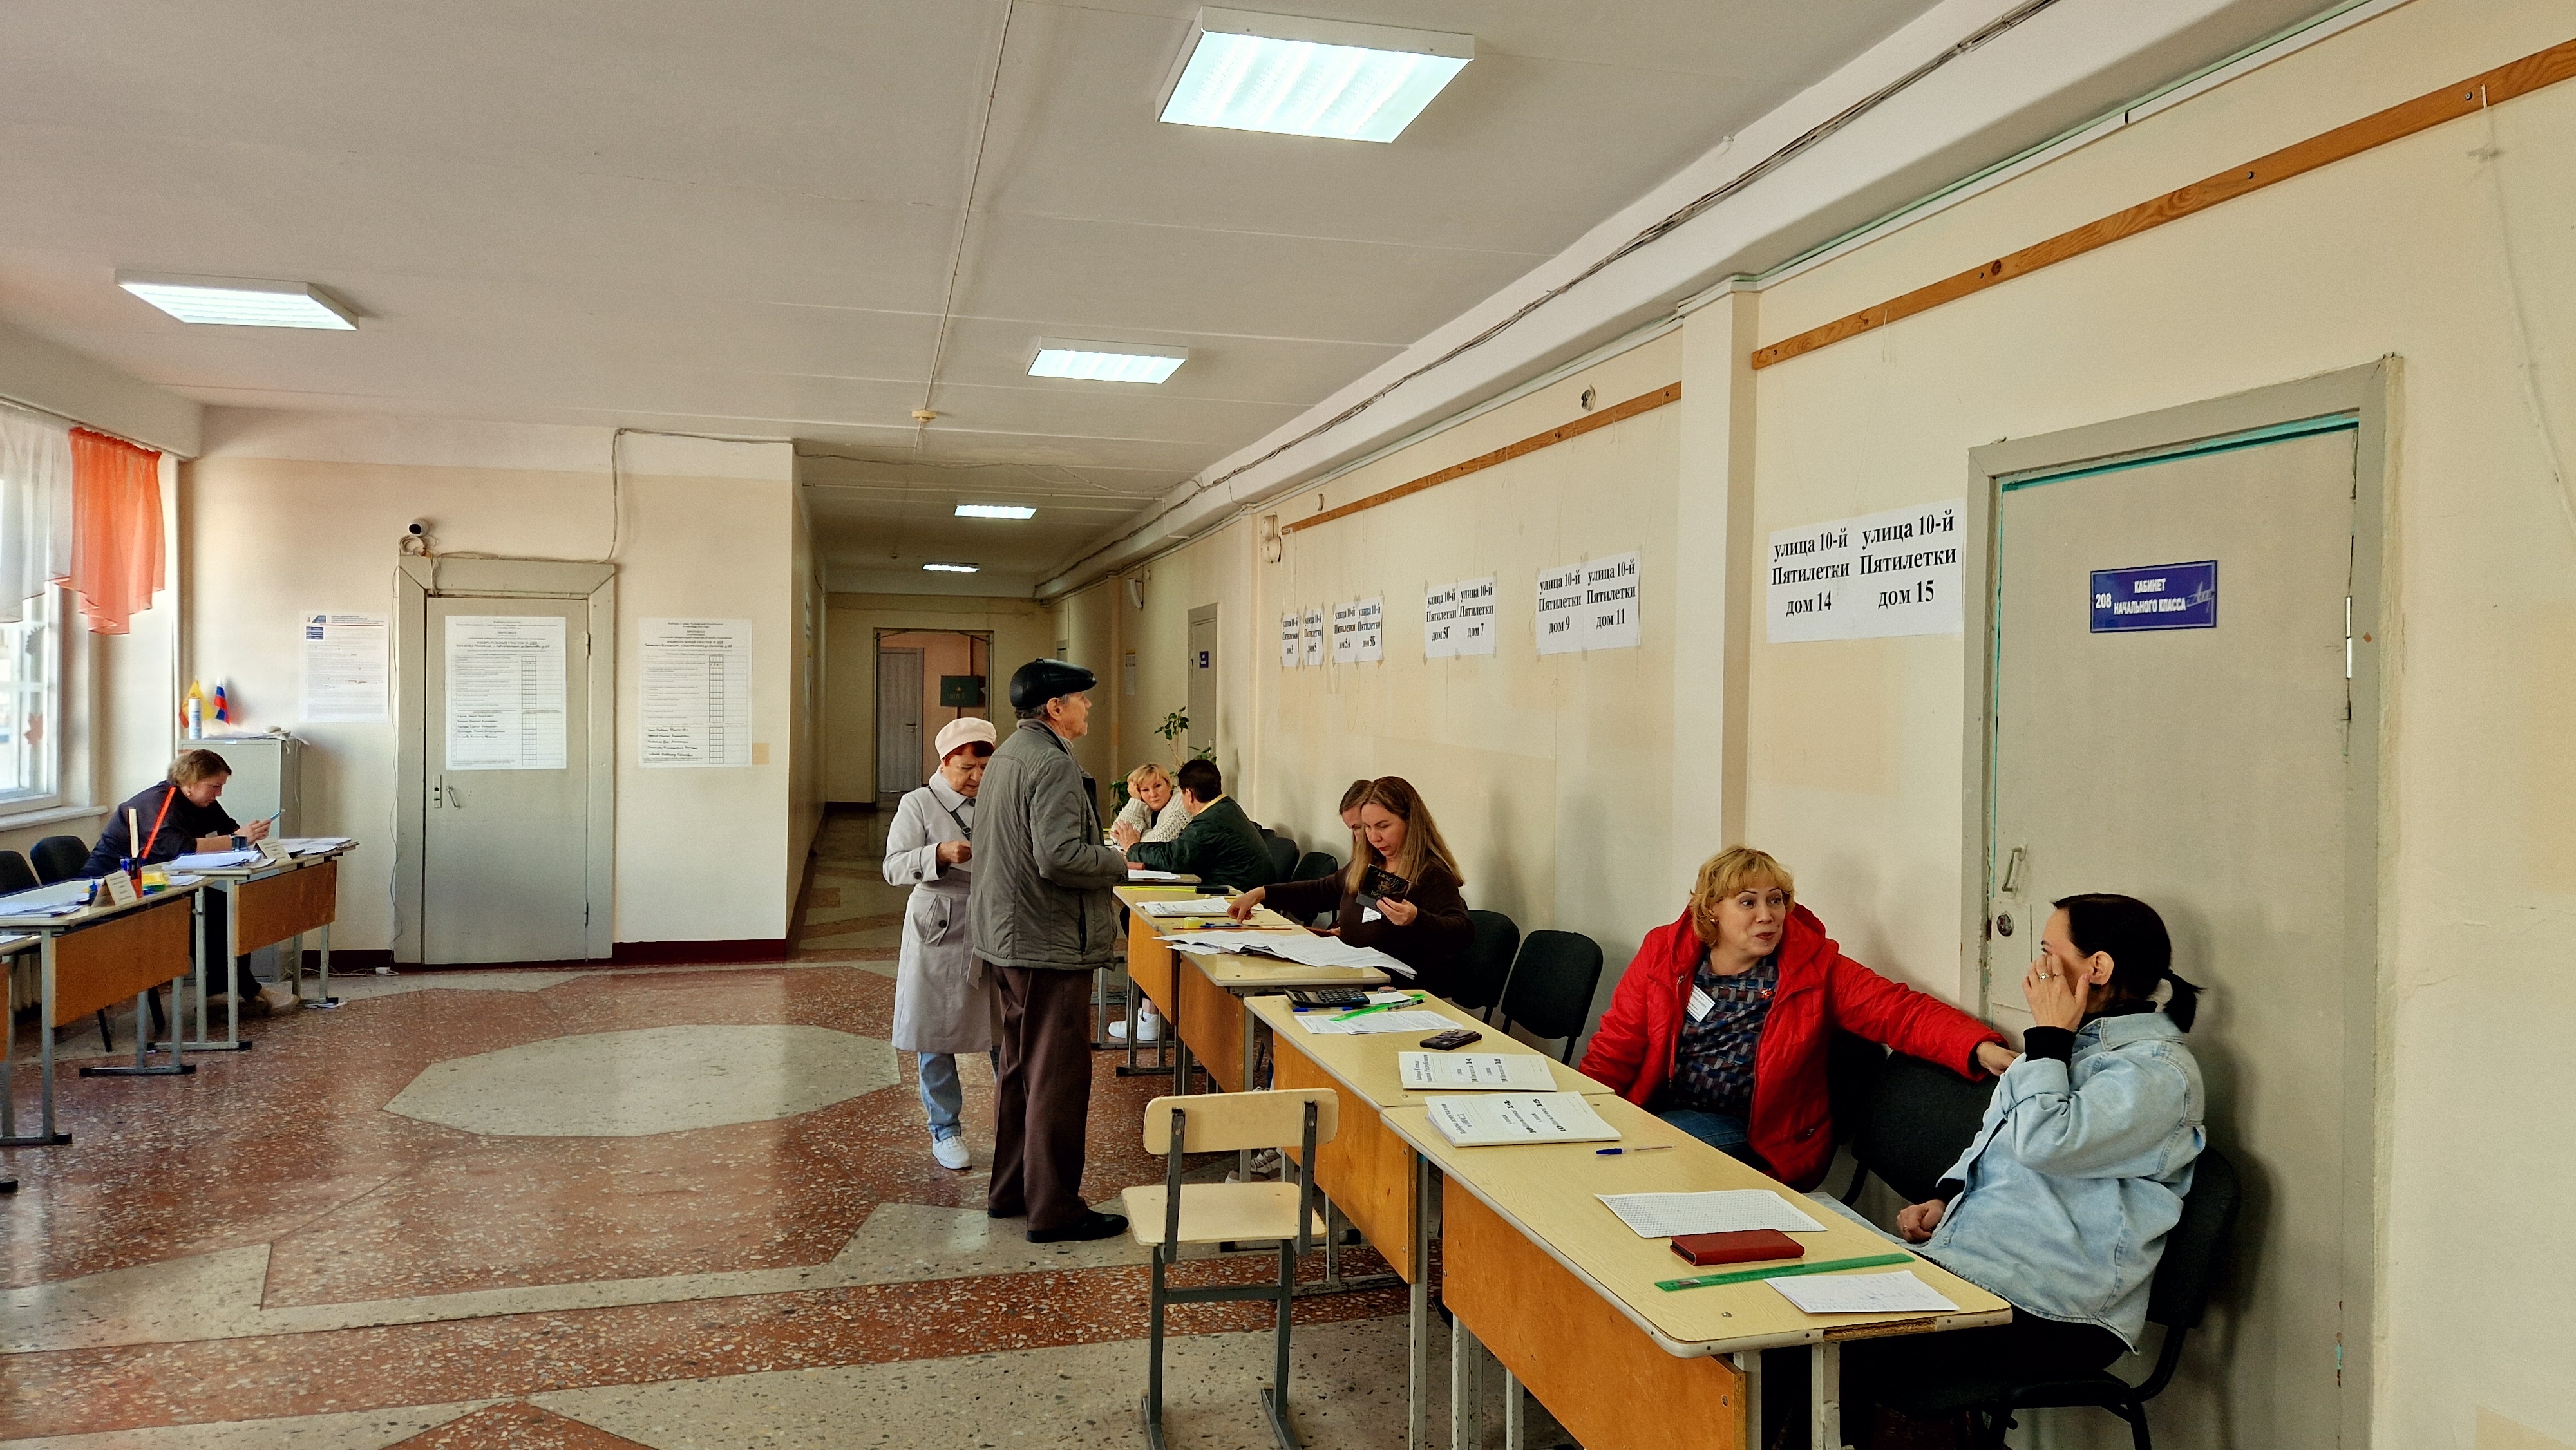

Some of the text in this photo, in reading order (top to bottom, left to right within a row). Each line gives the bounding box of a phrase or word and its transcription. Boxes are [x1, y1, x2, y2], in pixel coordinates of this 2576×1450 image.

[1862, 509, 1954, 549] улица 10-й
[1774, 528, 1848, 562] улица 10-й
[1860, 549, 1956, 575] Пятилетки
[1588, 558, 1634, 586] улица 10-й
[1772, 563, 1850, 585] Пятилетки
[1540, 569, 1580, 595] улица 10-й
[2134, 578, 2166, 593] КАБИНЕТ
[1428, 588, 1455, 608] улица 10-й
[1461, 582, 1492, 603] улица 10-й
[1587, 586, 1636, 604] Пятилетки
[1879, 580, 1934, 609] дом 15
[2096, 593, 2112, 608] 208
[1459, 605, 1493, 617] Пятилетки
[1539, 596, 1581, 612] Пятилетки
[1786, 590, 1831, 617] дом 14
[2114, 598, 2186, 615] НАЧАЛЬНОГО КЛАССА
[1426, 610, 1456, 622] Пятилетки
[1549, 616, 1570, 635] дом 9
[1596, 608, 1625, 630] дом 11
[1432, 626, 1450, 642] дом 5Г
[1468, 623, 1484, 638] дом 7
[1503, 1100, 1514, 1109] 14
[1532, 1098, 1543, 1107] 15
